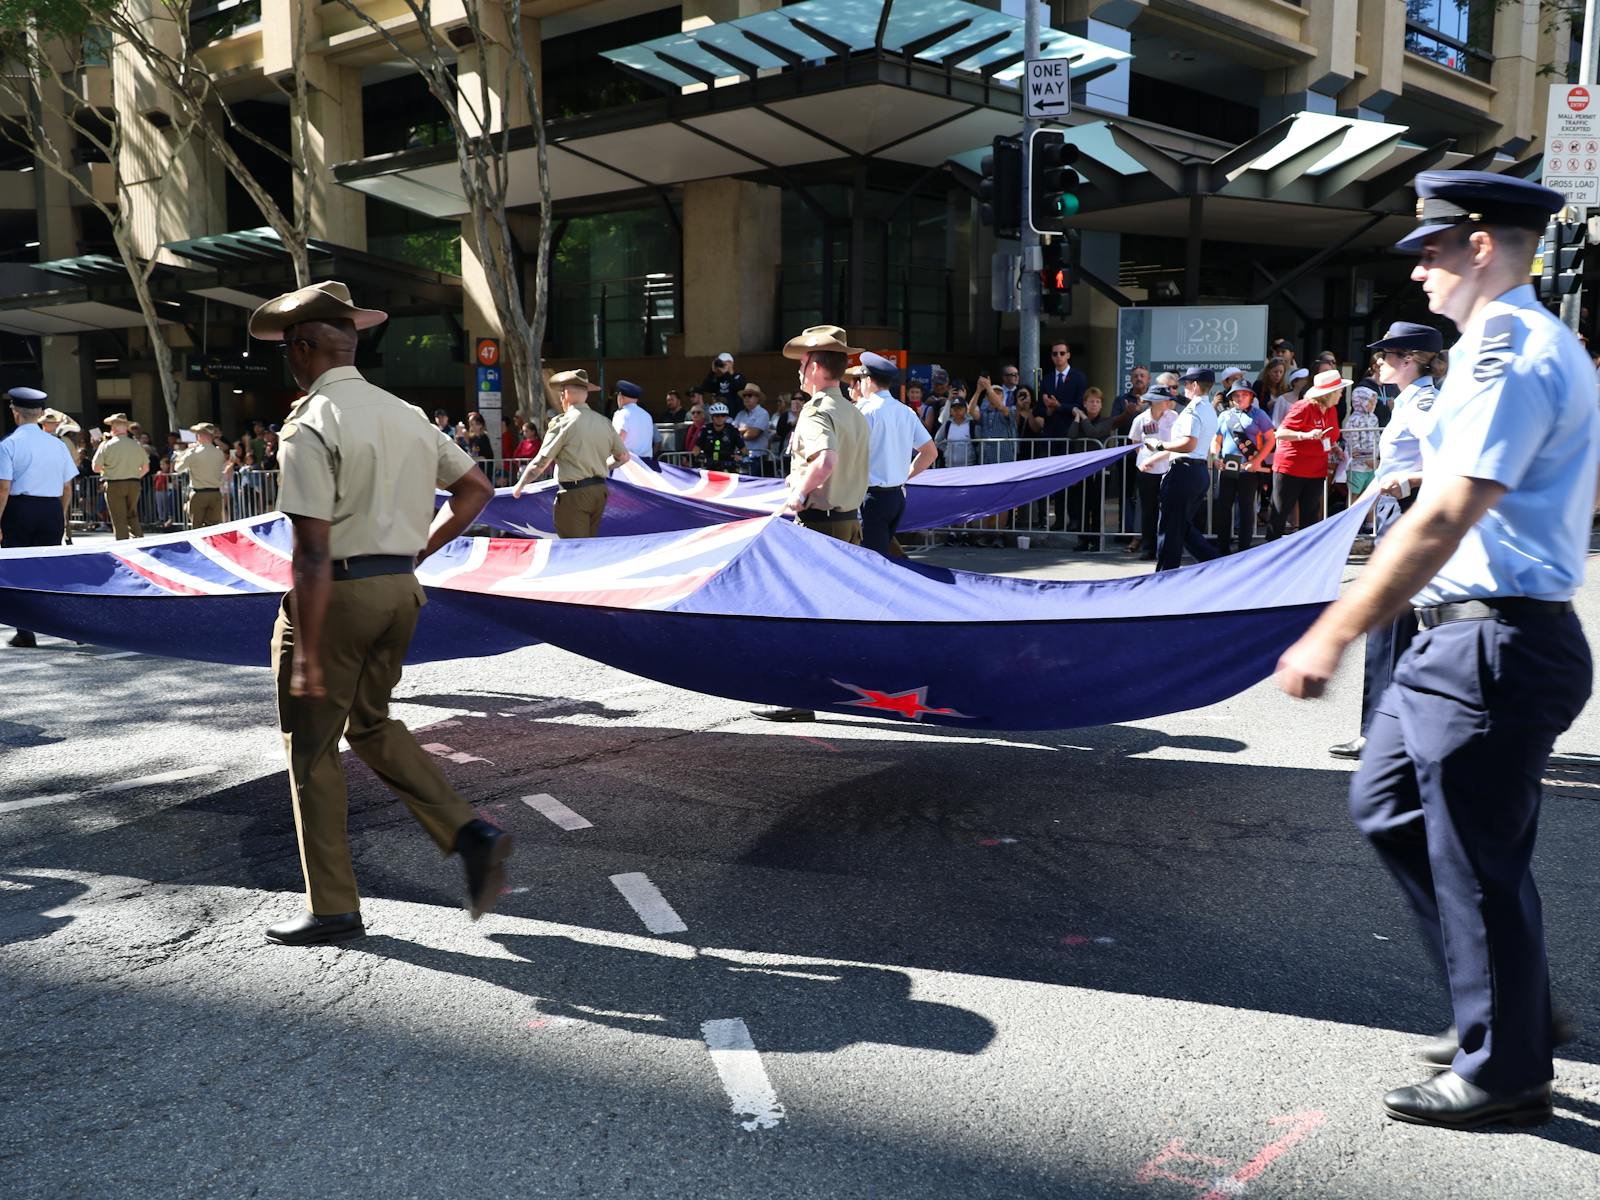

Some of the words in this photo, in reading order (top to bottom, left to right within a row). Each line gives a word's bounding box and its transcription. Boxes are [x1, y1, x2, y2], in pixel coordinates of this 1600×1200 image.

[1033, 64, 1062, 78] ONE
[1032, 81, 1064, 95] WAY
[1548, 180, 1573, 188] GROSS
[1575, 180, 1595, 188] LOAD
[1188, 318, 1239, 342] 239
[481, 346, 495, 359] 47
[1125, 339, 1135, 370] LEASE
[1175, 343, 1239, 355] GEORGE
